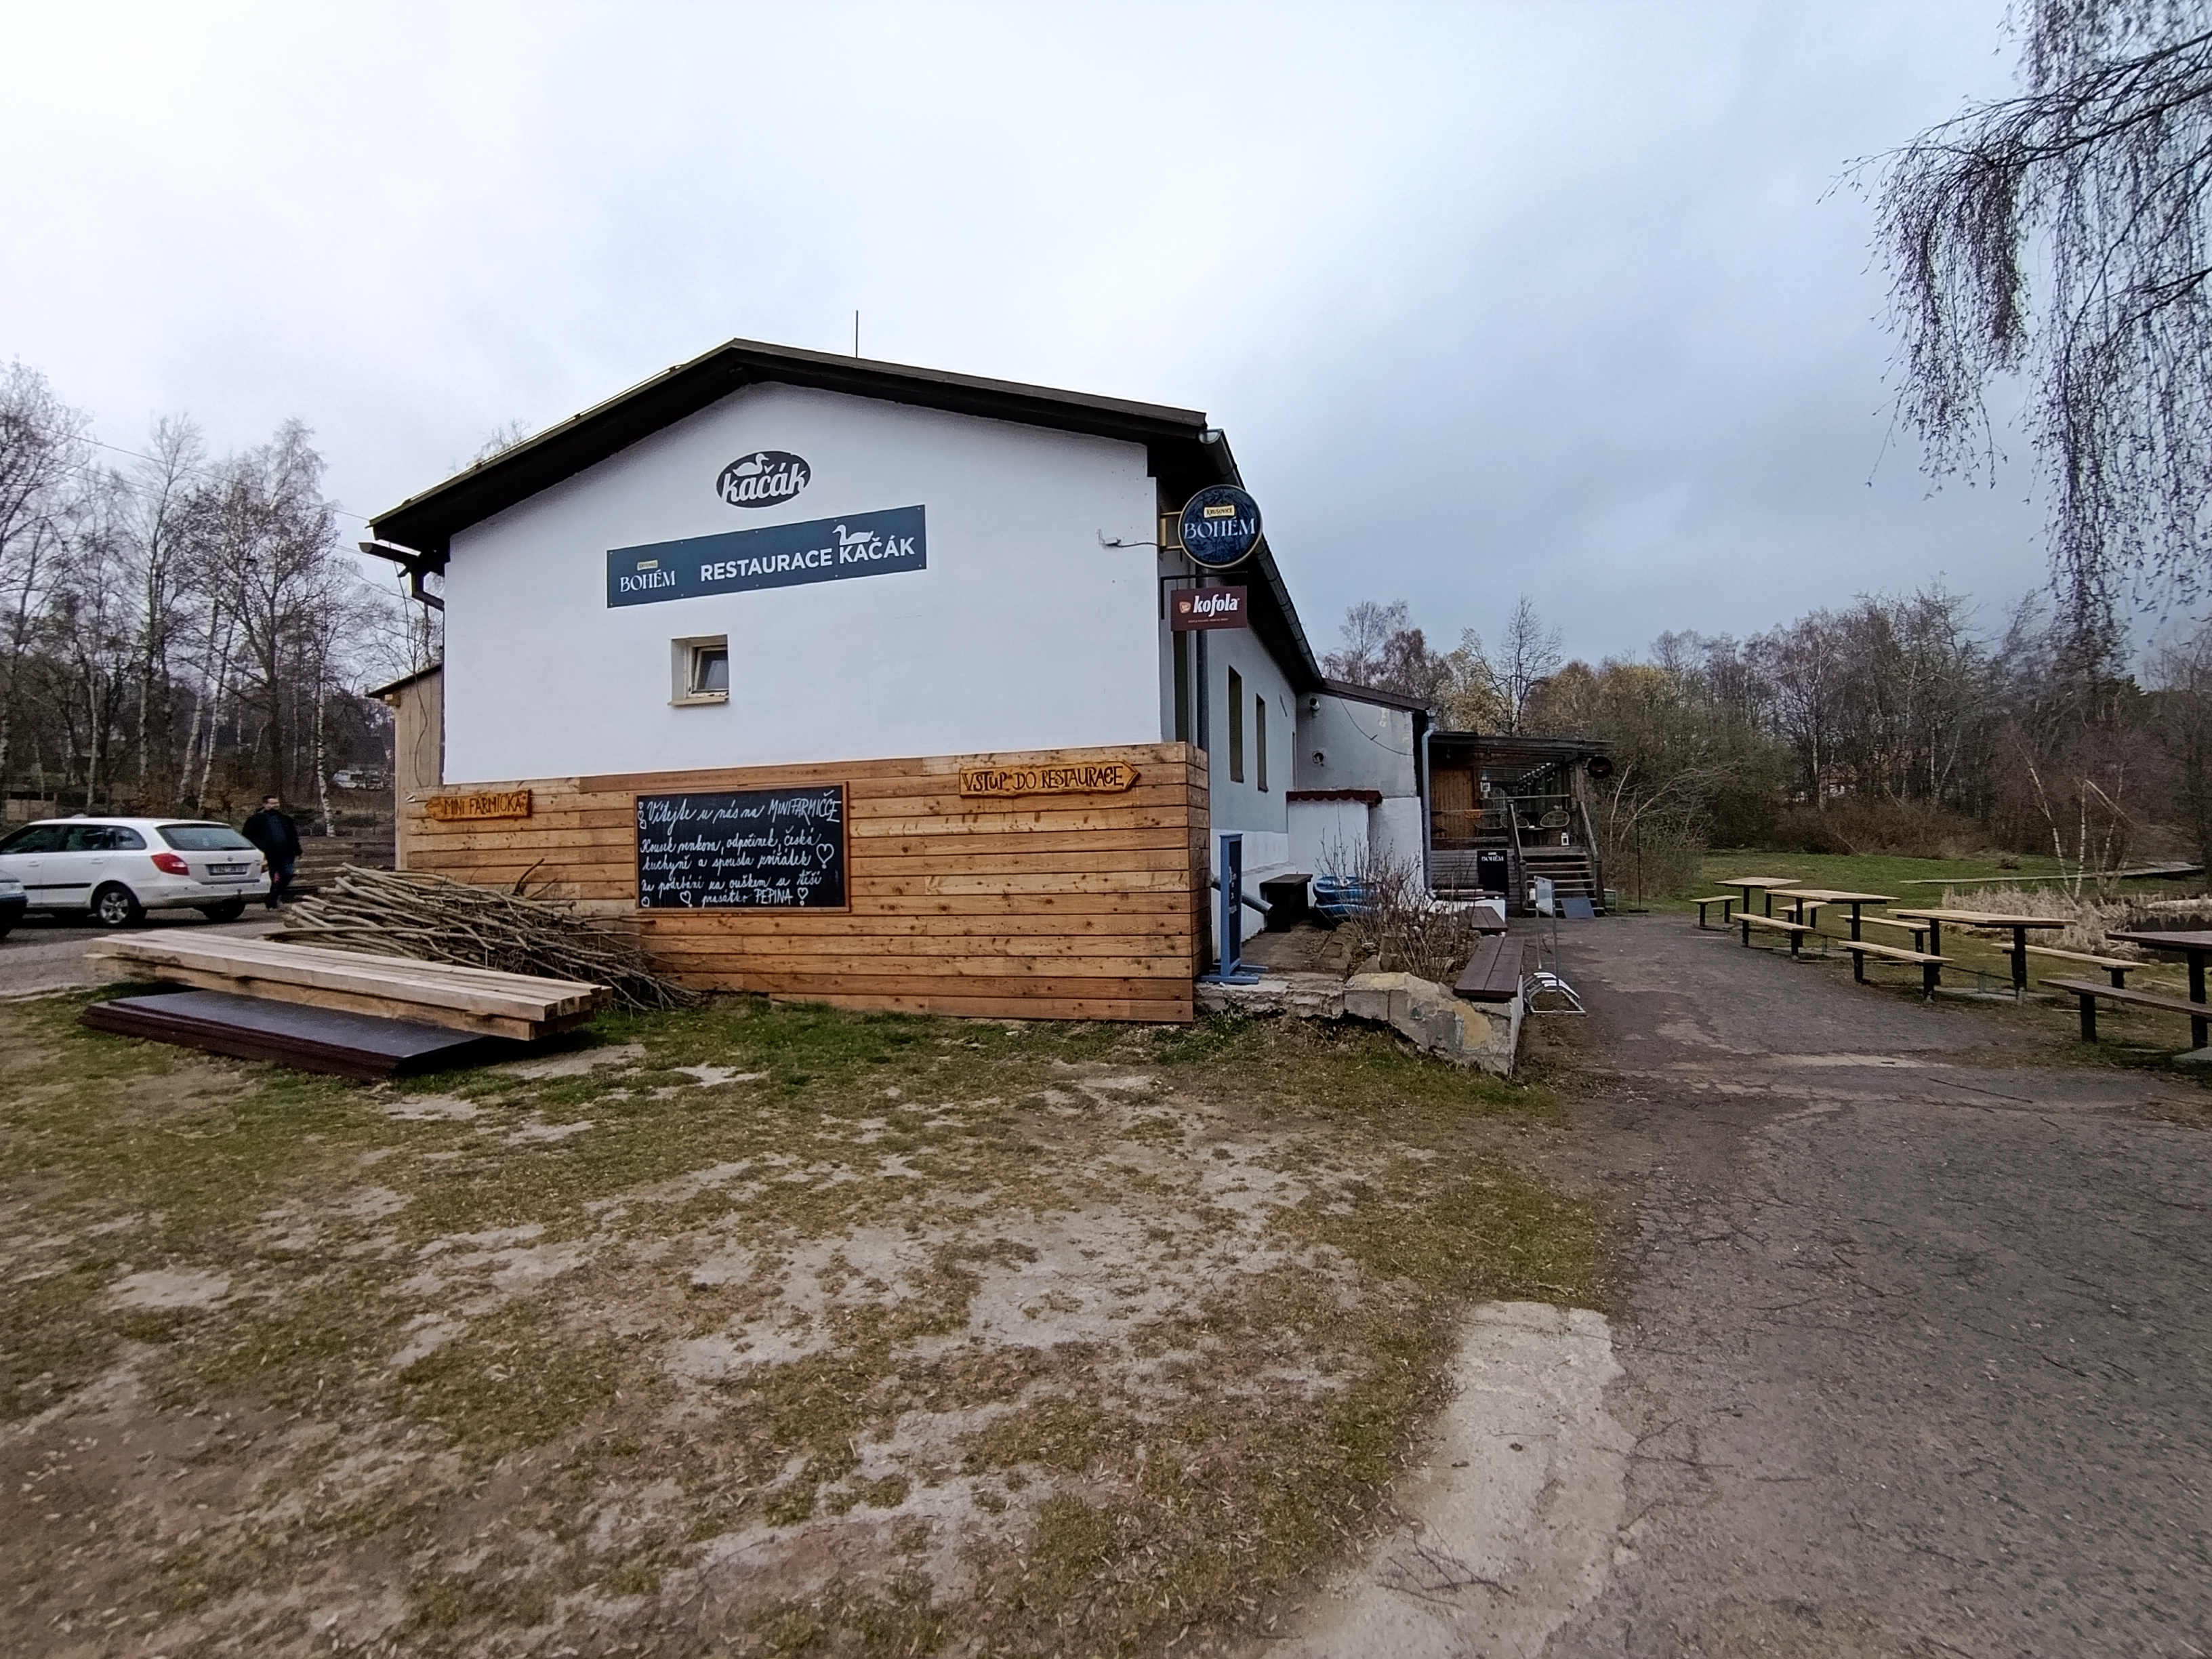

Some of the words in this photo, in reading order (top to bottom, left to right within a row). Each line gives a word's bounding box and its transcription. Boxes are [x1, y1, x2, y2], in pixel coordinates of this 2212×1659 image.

[722, 463, 807, 503] kačák
[1184, 516, 1256, 539] BOHÉM
[701, 548, 833, 581] RESTAURACE
[839, 536, 915, 564] KAČÁK
[620, 569, 676, 592] BOHÉM
[1193, 594, 1238, 617] kofola
[1012, 771, 1036, 790] DO
[1041, 766, 1124, 789] RESTAURACE
[647, 798, 697, 836] Vítejte
[713, 800, 739, 824] nás
[741, 805, 765, 819] na
[784, 825, 822, 846] česká
[642, 854, 692, 881] kuchyně
[698, 859, 708, 867] a
[754, 888, 794, 905] PEPINA
